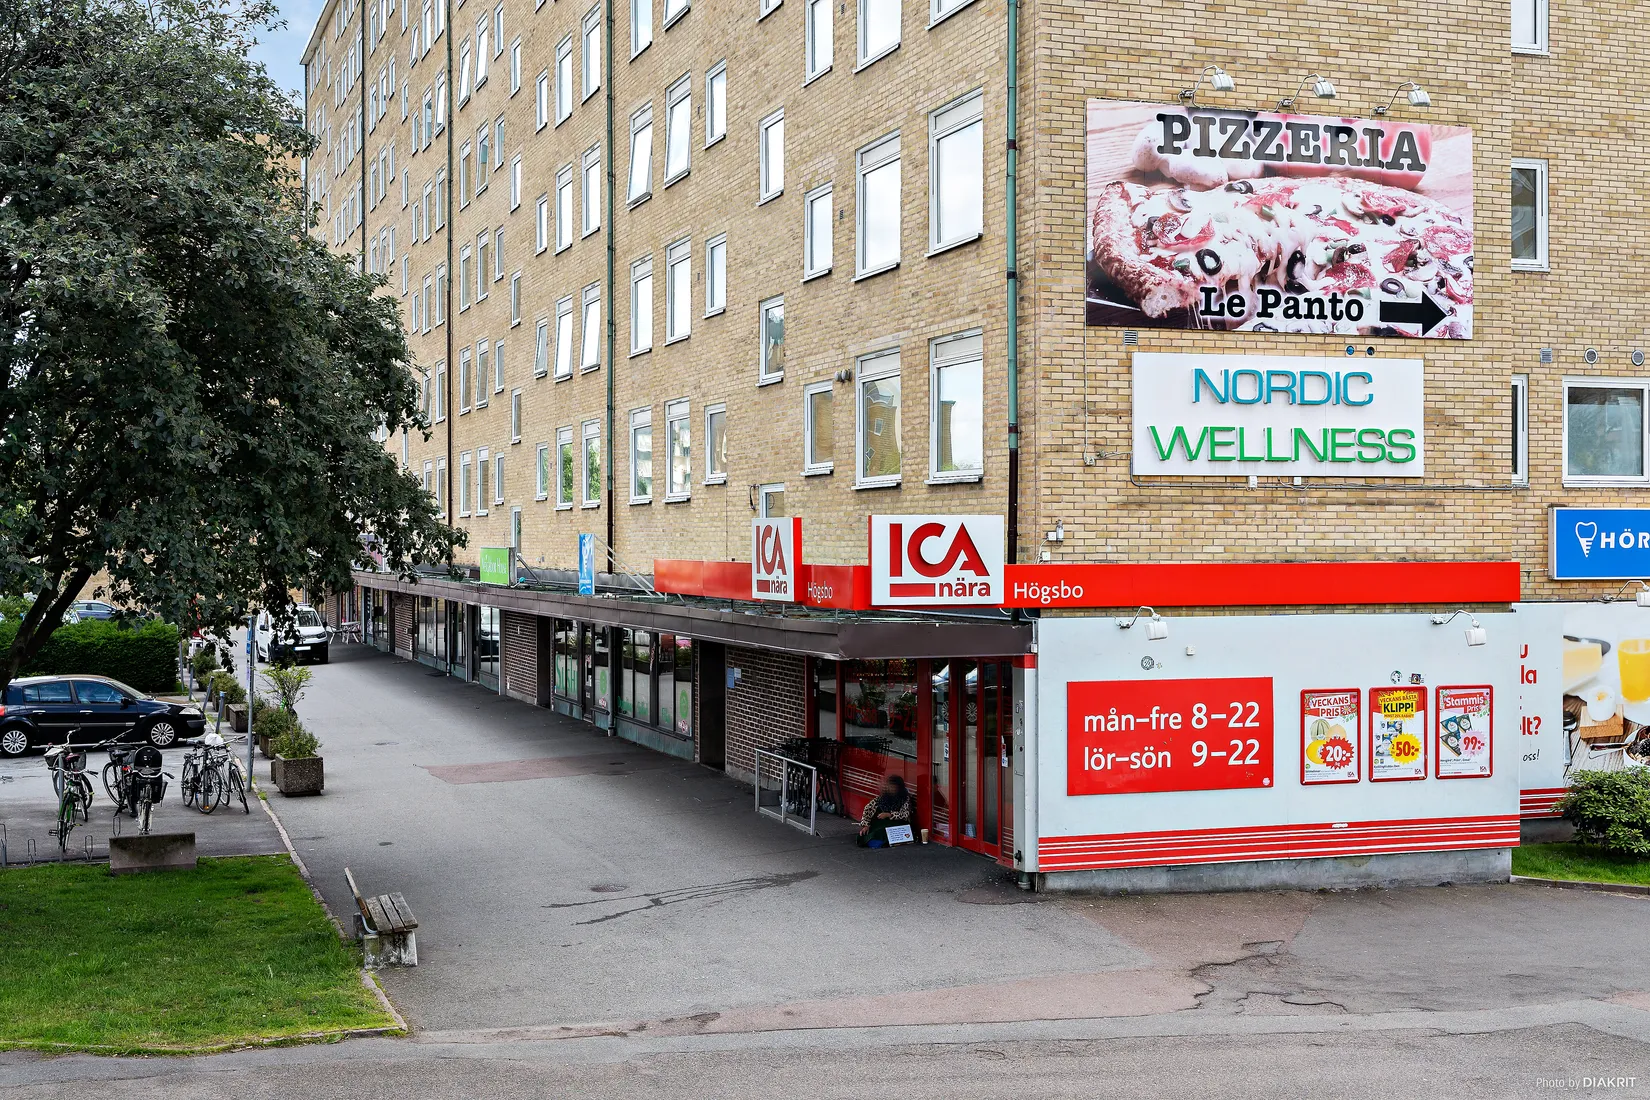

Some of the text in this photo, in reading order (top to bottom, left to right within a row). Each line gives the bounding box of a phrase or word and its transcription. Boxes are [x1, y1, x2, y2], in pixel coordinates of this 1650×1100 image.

[1156, 112, 1427, 173] PIZZERIA
[1199, 286, 1365, 323] Le Panto
[1192, 367, 1375, 407] NORDIC
[1147, 425, 1417, 463] WELLNESS
[1600, 528, 1650, 549] HÖR
[756, 524, 787, 575] ICA
[889, 522, 990, 577] ICA
[771, 575, 788, 594] nära
[807, 580, 833, 603] Högsbo
[939, 577, 990, 597] nära
[1013, 581, 1084, 604] Högsbo
[1311, 696, 1349, 707] VECKANS
[1383, 702, 1414, 713] KLIPP!
[1445, 694, 1484, 707] Stammis
[1084, 701, 1260, 732] mån-fre 8-22
[1320, 707, 1340, 717] PRIS
[1325, 745, 1351, 762] 20:-
[1395, 740, 1420, 757] 50:-
[1463, 735, 1485, 751] 99:-
[1084, 738, 1260, 771] lör-sön 9-22
[1522, 748, 1540, 762] oss!
